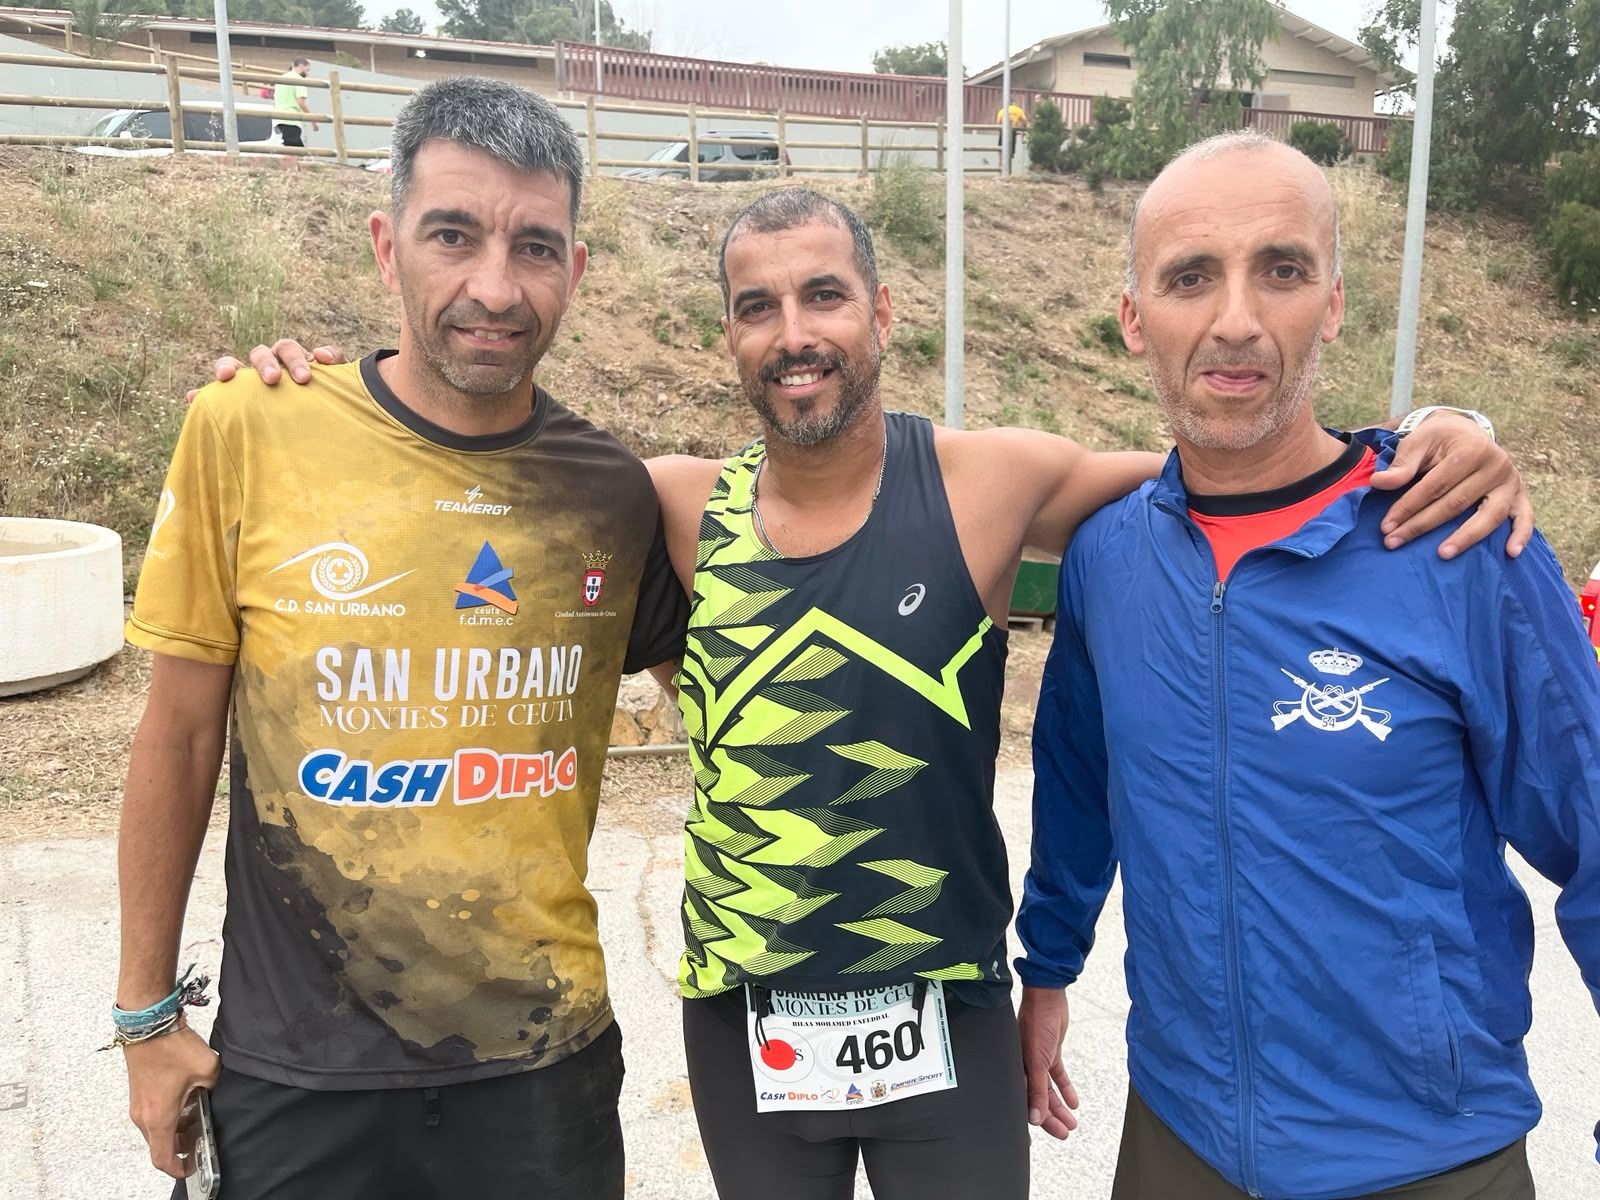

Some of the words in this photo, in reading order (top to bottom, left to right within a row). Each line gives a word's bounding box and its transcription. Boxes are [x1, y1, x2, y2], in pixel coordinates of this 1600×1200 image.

[434, 500, 512, 515] TEAMERGY
[274, 599, 300, 613] C.D.
[305, 600, 336, 614] SAN
[340, 602, 406, 617] URBANO
[474, 607, 501, 615] ceuta
[554, 610, 575, 618] Ciudad
[459, 614, 514, 626] f.d.m.e.c
[316, 646, 411, 702] SAN
[434, 644, 583, 702] URBANO
[319, 703, 449, 734] MONTES
[460, 704, 498, 728] DE
[507, 698, 574, 726] CEUTA
[1321, 715, 1337, 728] 54
[300, 751, 450, 806] CASH
[456, 748, 578, 803] DIPLO
[776, 998, 848, 1017] MONTES
[854, 997, 878, 1012] DE
[836, 1020, 921, 1074] 460
[760, 1091, 786, 1101] CASH
[787, 1091, 819, 1101] DIPLO
